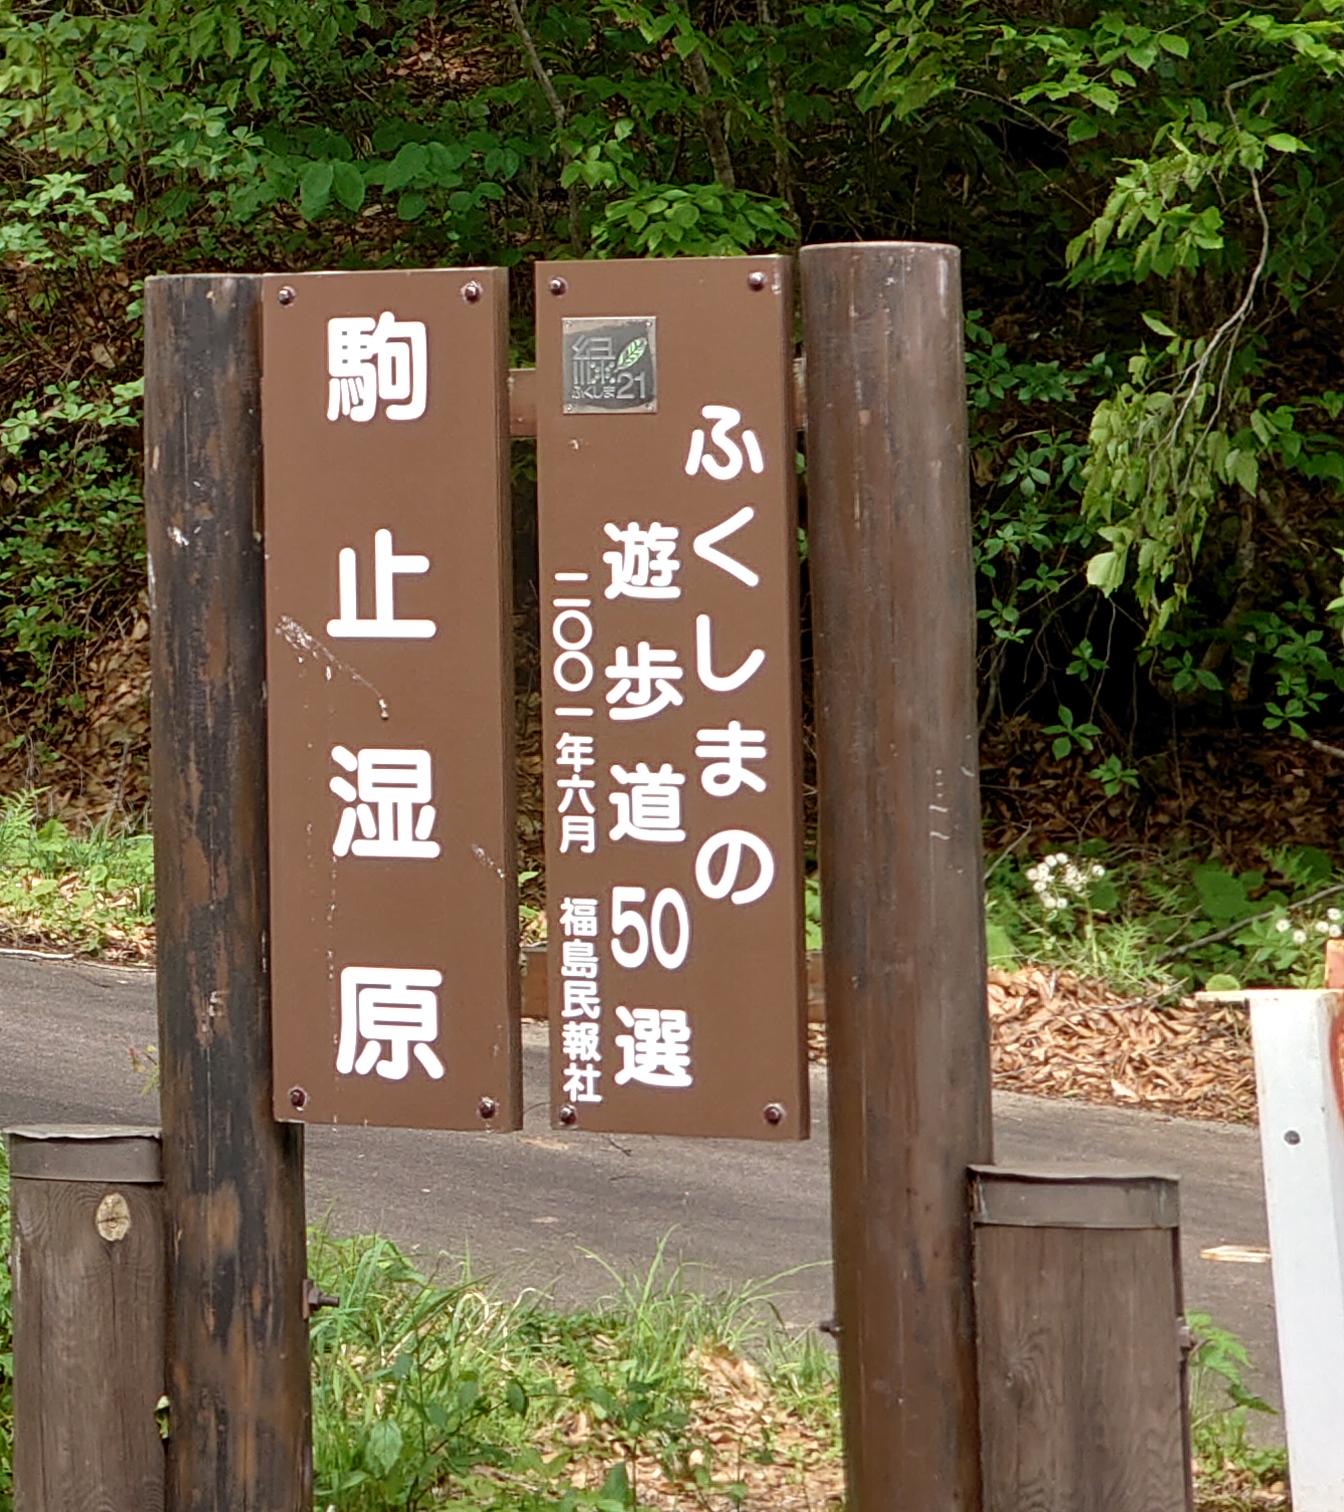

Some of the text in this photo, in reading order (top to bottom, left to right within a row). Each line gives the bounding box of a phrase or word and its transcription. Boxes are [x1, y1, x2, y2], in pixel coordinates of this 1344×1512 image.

[325, 311, 444, 1081] 駒止湿原
[603, 522, 693, 1088] 遊歩道50選
[685, 405, 775, 906] ふくしまの
[559, 897, 603, 1104] 福島民報社
